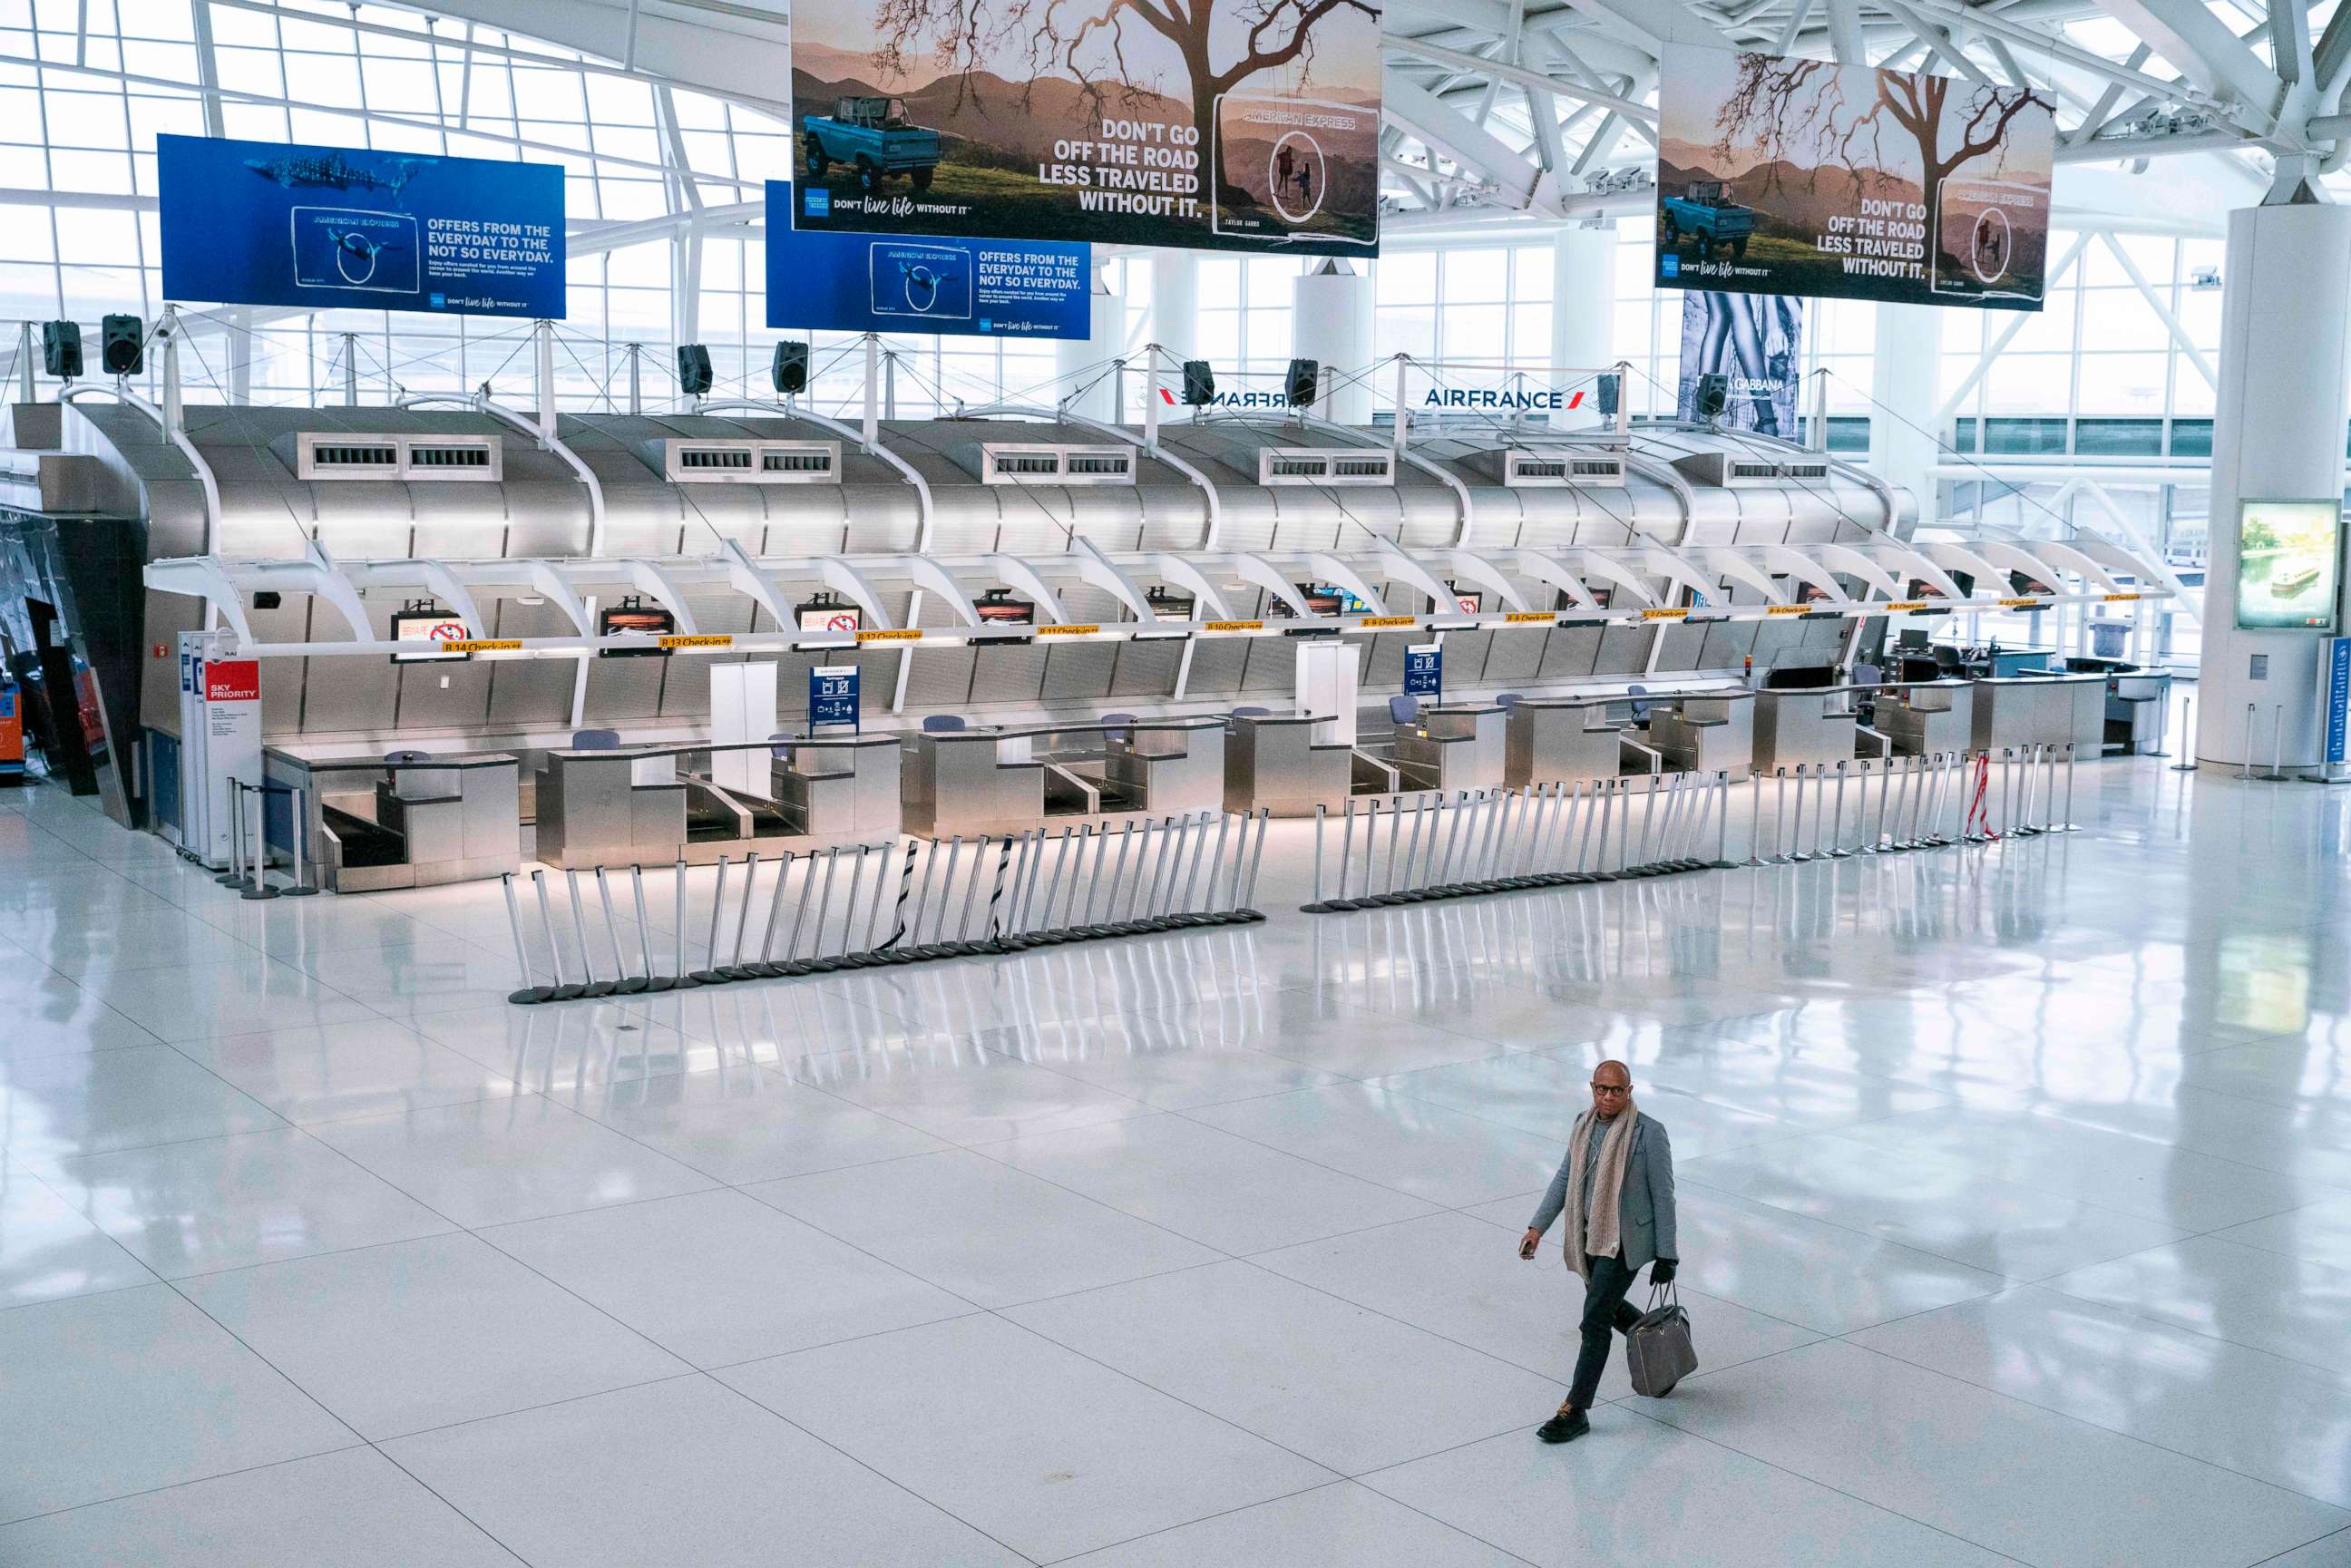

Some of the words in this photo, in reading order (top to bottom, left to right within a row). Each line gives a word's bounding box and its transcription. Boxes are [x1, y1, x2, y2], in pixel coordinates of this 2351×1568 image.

[1243, 108, 1303, 125] AMERICAN
[1305, 115, 1356, 130] EXPRESS
[1169, 124, 1199, 146] GO
[1054, 140, 1094, 161] OFF
[1097, 142, 1137, 165] THE
[1144, 147, 1199, 170] ROAD
[1039, 164, 1090, 186] LESS
[1096, 167, 1199, 193] TRAVELED
[863, 196, 890, 214] live
[892, 196, 915, 218] life
[917, 204, 956, 214] WITHOUT
[1078, 190, 1174, 216] WITHOUT
[1179, 199, 1202, 218] IT.
[1907, 203, 1927, 219] GO
[428, 219, 480, 233] OFFERS
[483, 222, 521, 235] FROM
[524, 224, 551, 237] THE
[1829, 216, 1855, 233] OFF
[1858, 218, 1885, 236] THE
[1888, 221, 1926, 239] ROAD
[428, 232, 497, 247] EVERYDAY
[501, 237, 519, 248] TO
[522, 238, 548, 250] THE
[1817, 235, 1852, 253] LESS
[1855, 239, 1924, 259] TRAVELED
[429, 245, 457, 258] NOT
[461, 247, 479, 258] SO
[483, 248, 553, 263] EVERYDAY.
[980, 251, 1021, 263] OFFERS
[1024, 254, 1055, 265] FROM
[1058, 256, 1078, 266] THE
[980, 264, 1035, 276] EVERYDAY
[1038, 267, 1052, 277] TO
[1055, 268, 1076, 278] THE
[1701, 261, 1718, 275] live
[1719, 261, 1733, 278] life
[1735, 268, 1761, 276] WITHOUT
[1843, 258, 1907, 277] WITHOUT
[1908, 263, 1925, 279] IT.
[980, 276, 1002, 287] NOT
[1005, 277, 1020, 287] SO
[1023, 278, 1080, 289] EVERYDAY.
[464, 297, 481, 307] live
[482, 297, 495, 308] life
[1008, 321, 1020, 330] live
[1021, 321, 1032, 332] life
[1734, 378, 1784, 391] GABBANA
[1425, 389, 1563, 409] AIRFRANCE
[455, 643, 466, 651] 14
[469, 642, 510, 651] Check-in
[683, 638, 721, 647] Check-in
[210, 690, 256, 698] PRIORITY
